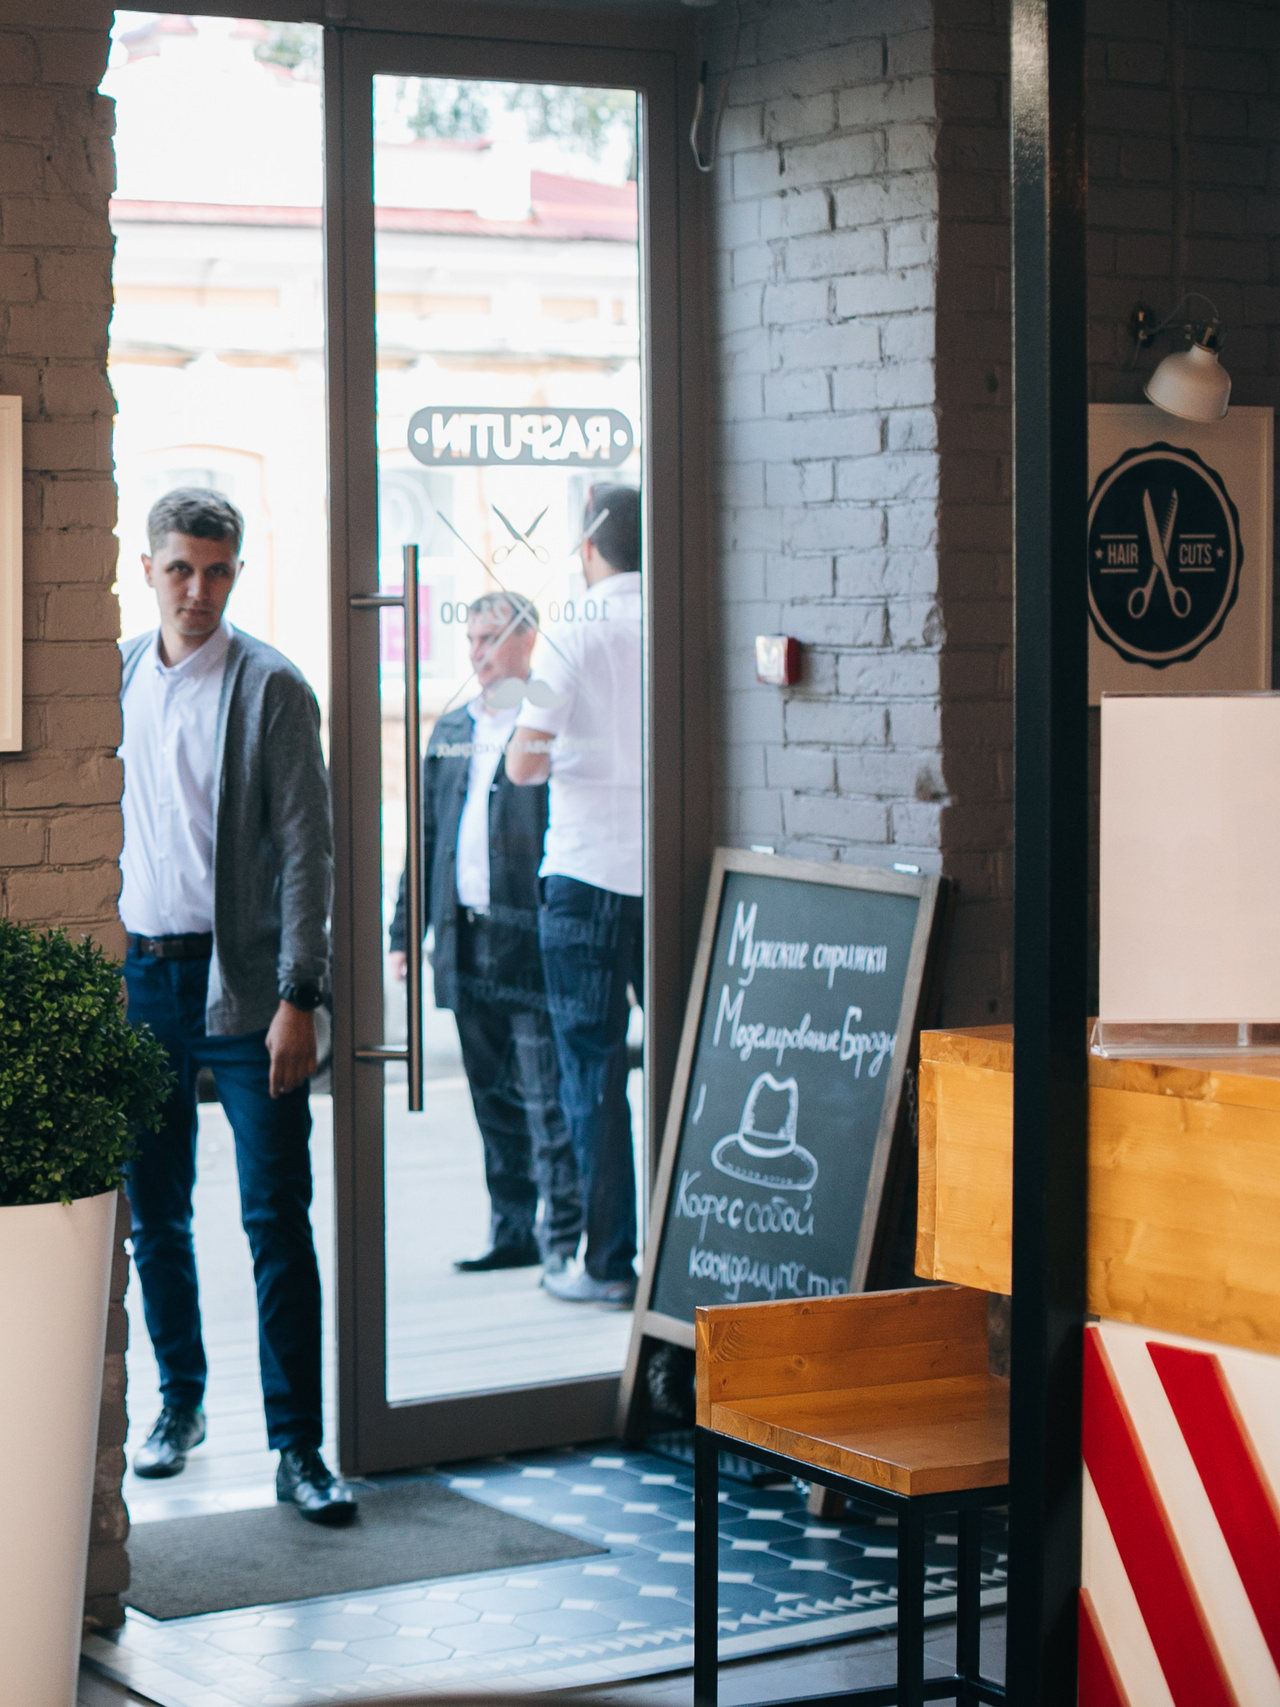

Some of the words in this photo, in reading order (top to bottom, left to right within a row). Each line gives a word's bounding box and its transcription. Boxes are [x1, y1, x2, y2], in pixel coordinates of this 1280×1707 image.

[1107, 543, 1139, 565] HAIR
[1179, 543, 1212, 565] CUTS
[727, 900, 810, 986] Мужские
[674, 1170, 728, 1244] Кофе
[744, 1191, 815, 1236] собой
